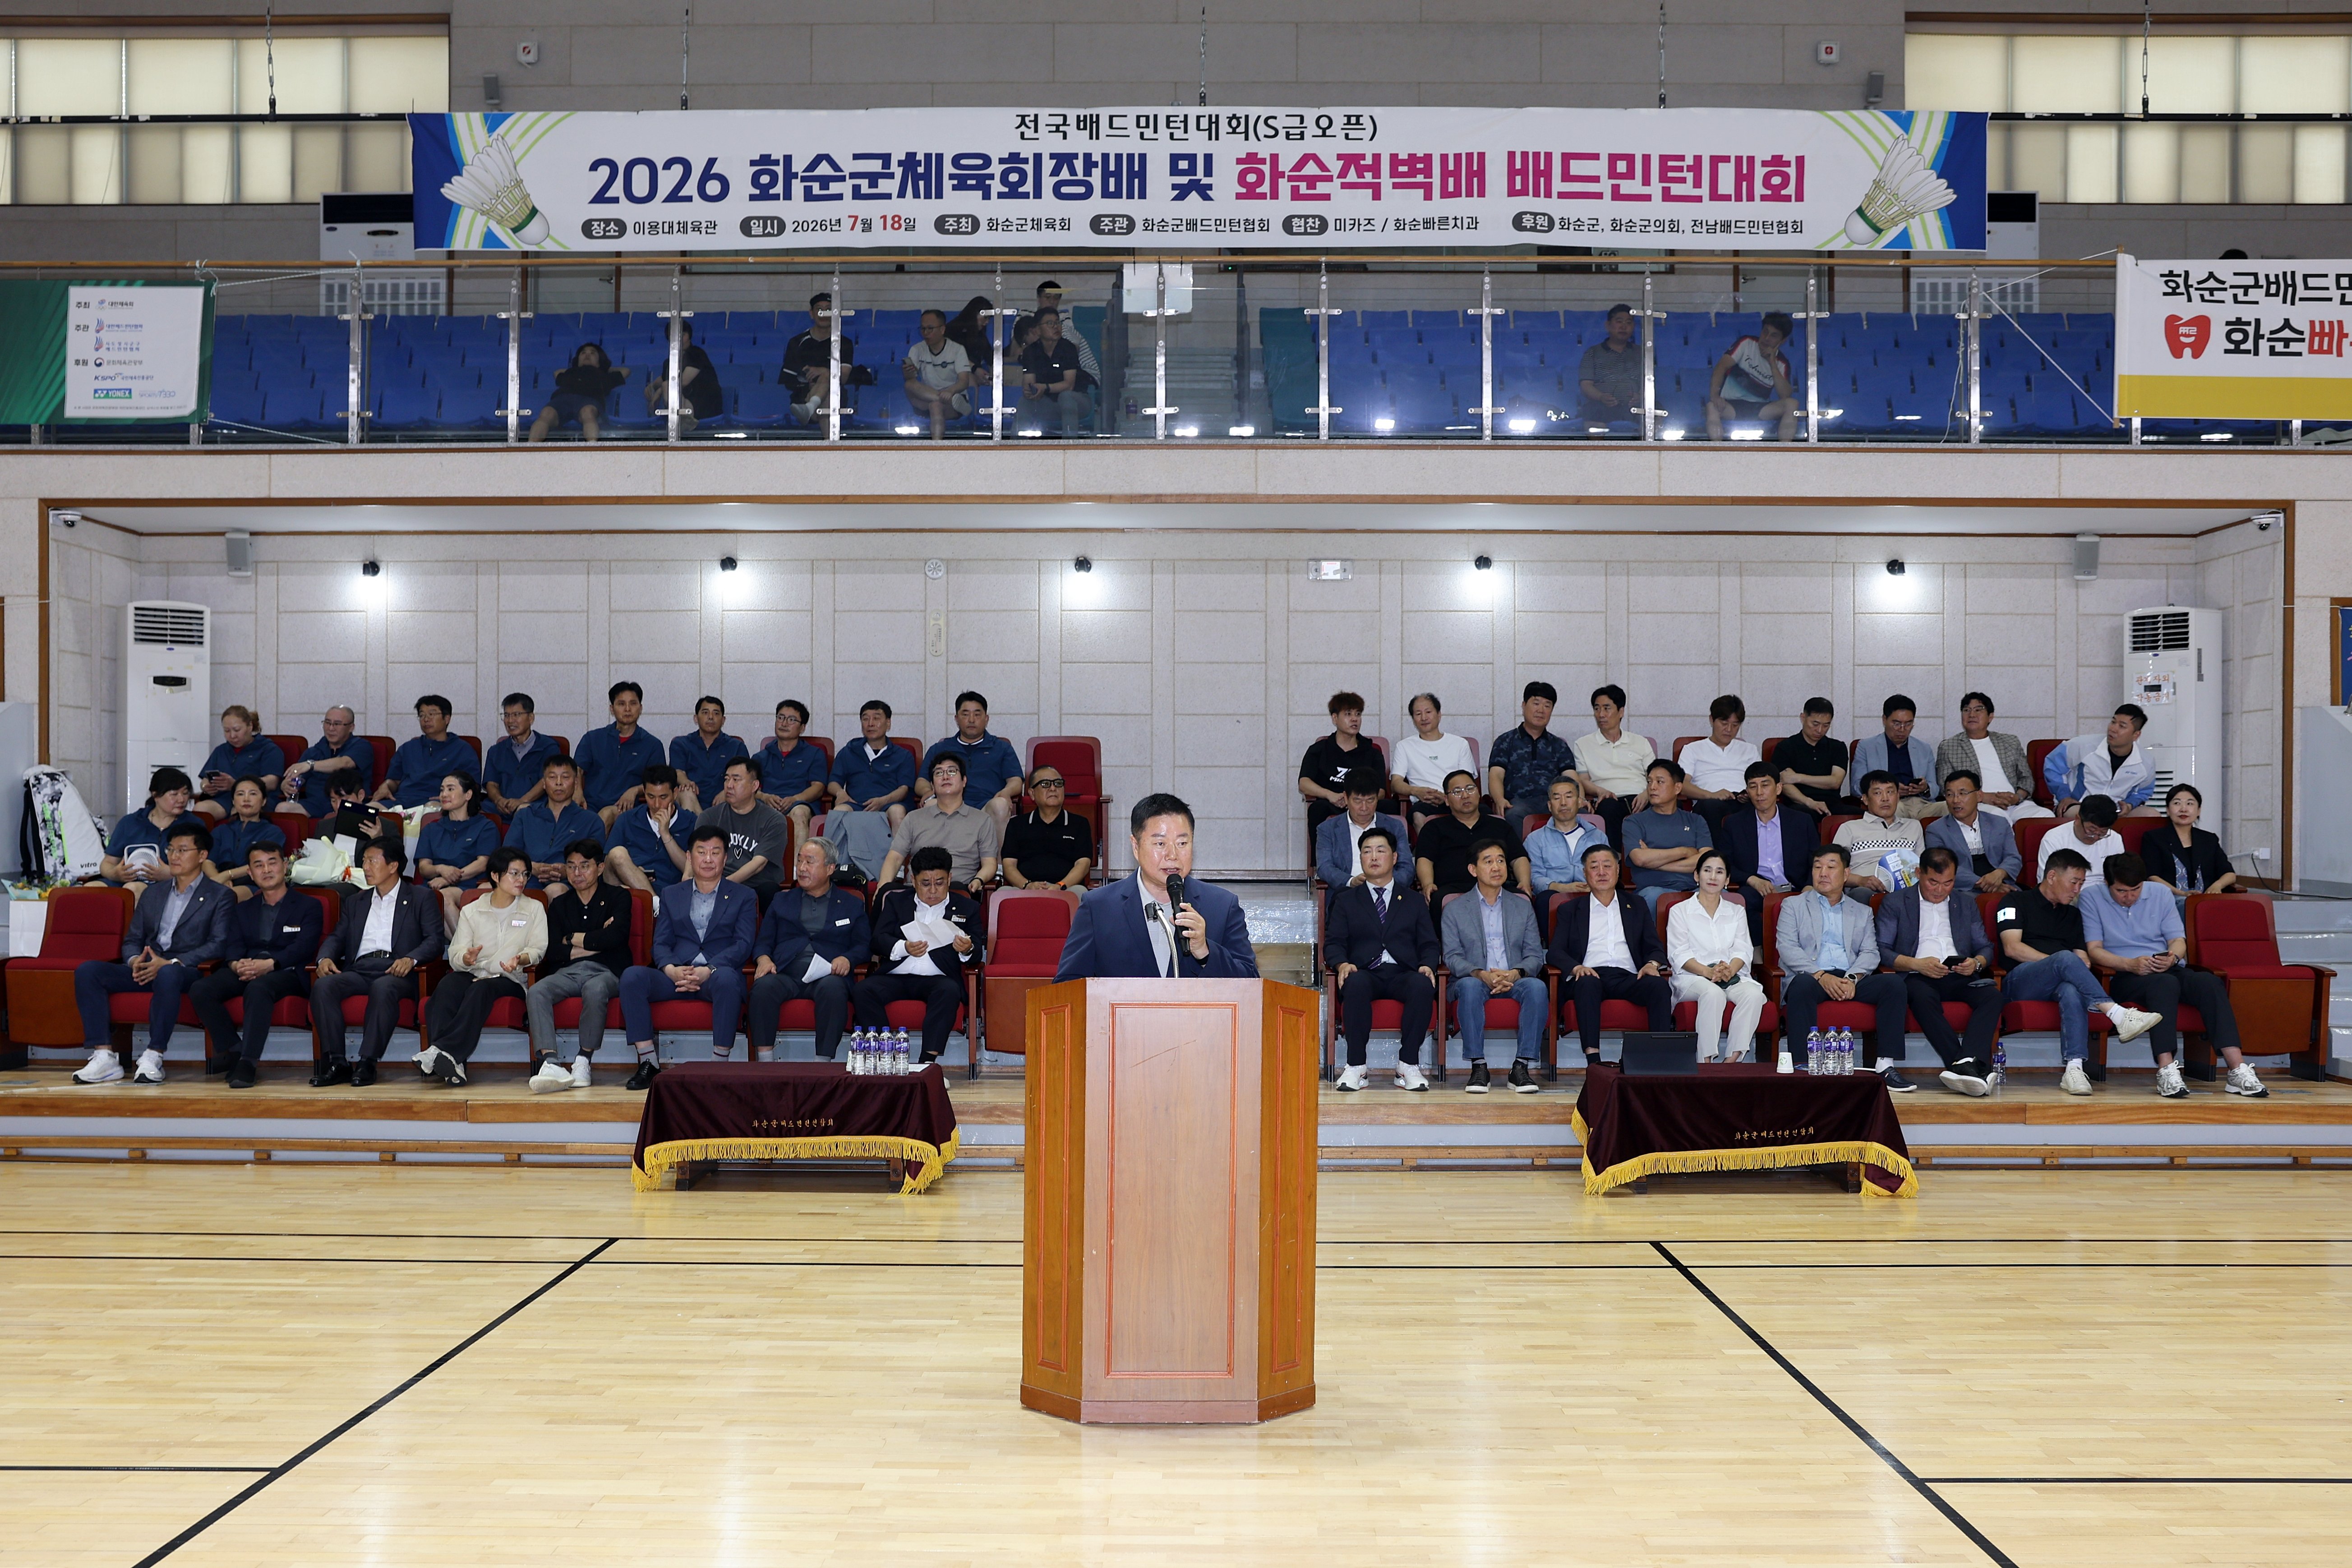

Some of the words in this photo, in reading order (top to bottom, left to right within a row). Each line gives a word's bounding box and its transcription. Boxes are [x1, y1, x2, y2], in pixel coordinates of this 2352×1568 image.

[1015, 113, 1377, 142] 전국배드민턴대회(S급오픈)
[588, 157, 730, 204] 2026
[748, 152, 1147, 202] 화순군체육회장배
[1169, 153, 1215, 201] 및
[1235, 152, 1486, 201] 화순적벽배
[1507, 151, 1805, 203] 배드민턴대회
[590, 221, 619, 236] 장소
[633, 220, 718, 235] 이용대체육관
[750, 219, 778, 235] 일시
[792, 218, 842, 233] 2026년
[848, 215, 872, 233] 7월
[880, 214, 916, 231] 18일
[944, 217, 972, 233] 주최
[987, 217, 1071, 232] 화순군체육회
[1100, 217, 1129, 233] 주관
[1142, 217, 1270, 232] 화순군배드민턴협회
[1291, 217, 1320, 233] 협찬
[1334, 217, 1376, 232] 미카즈
[1394, 216, 1480, 231] 화순빠른치과
[1522, 214, 1550, 231] 후원
[1559, 217, 1605, 233] 화순군,
[1610, 217, 1685, 235] 화순군의회,
[1691, 219, 1803, 235] 전남배드민턴협회
[2224, 317, 2352, 357] 화순빠
